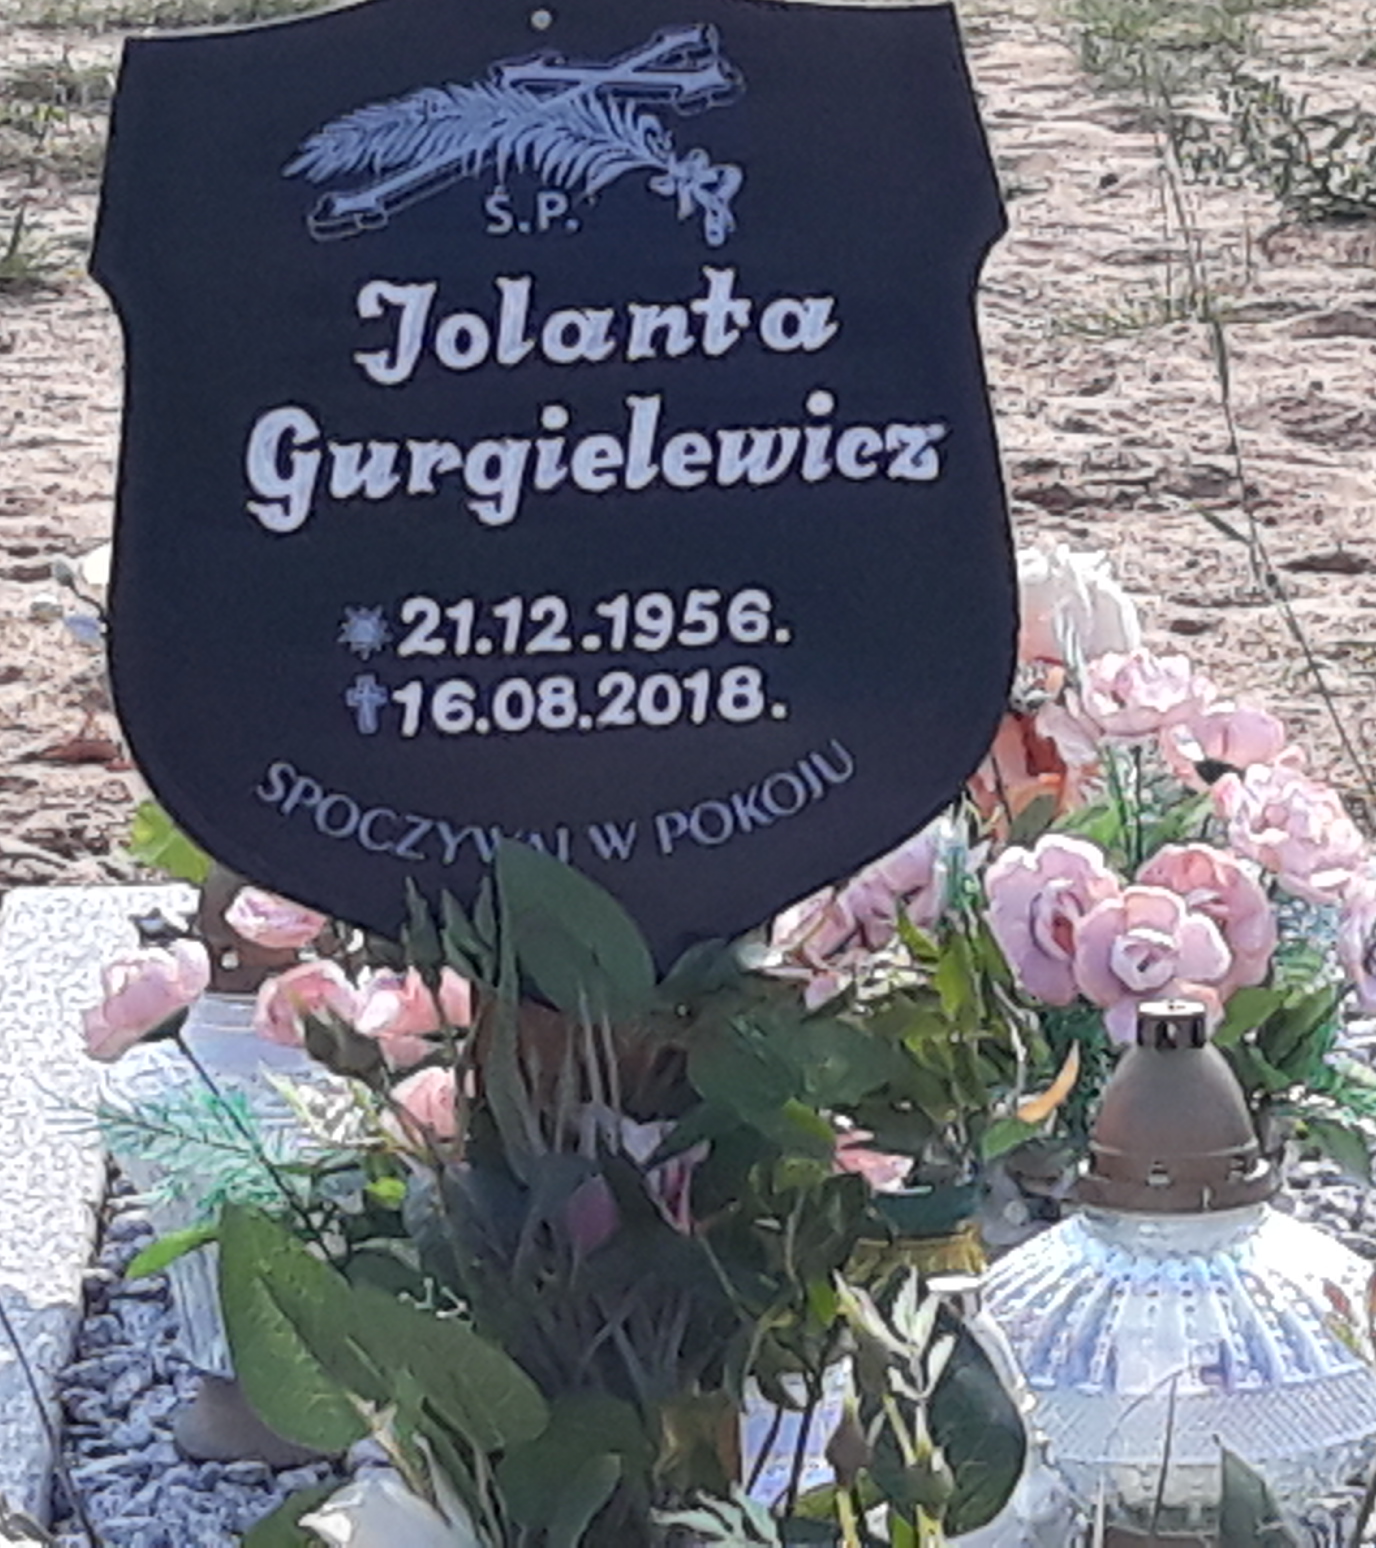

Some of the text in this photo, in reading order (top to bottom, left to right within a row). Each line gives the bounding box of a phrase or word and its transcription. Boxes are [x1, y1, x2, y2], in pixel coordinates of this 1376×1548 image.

[354, 267, 837, 385] Jolanta
[245, 391, 947, 533] Gurgielewicz
[397, 589, 792, 655] 21.12.1956.
[391, 666, 788, 736] 16.08.2018.
[587, 821, 638, 861] W
[655, 738, 857, 856] POKOJU
